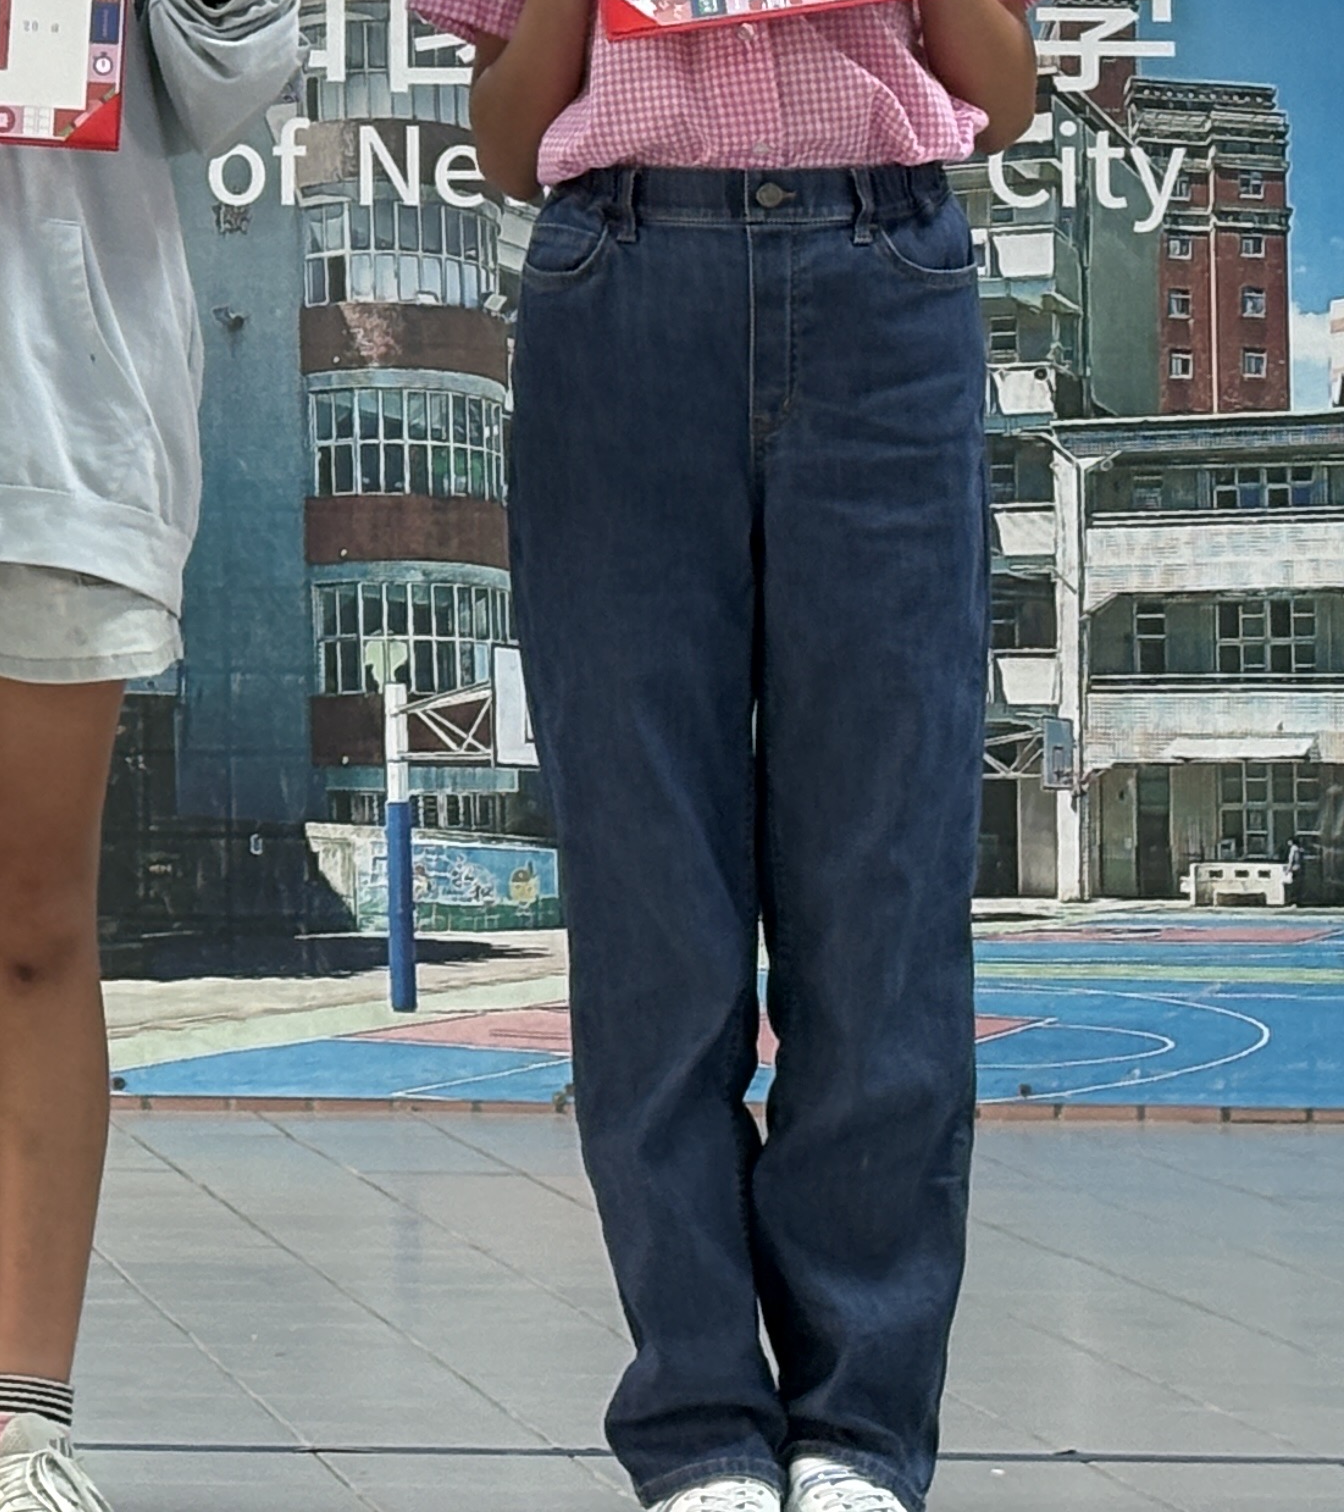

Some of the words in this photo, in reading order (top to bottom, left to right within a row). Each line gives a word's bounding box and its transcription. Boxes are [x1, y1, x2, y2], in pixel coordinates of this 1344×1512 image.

[208, 117, 311, 207] of
[359, 125, 487, 208] Ne
[988, 112, 1187, 233] City
